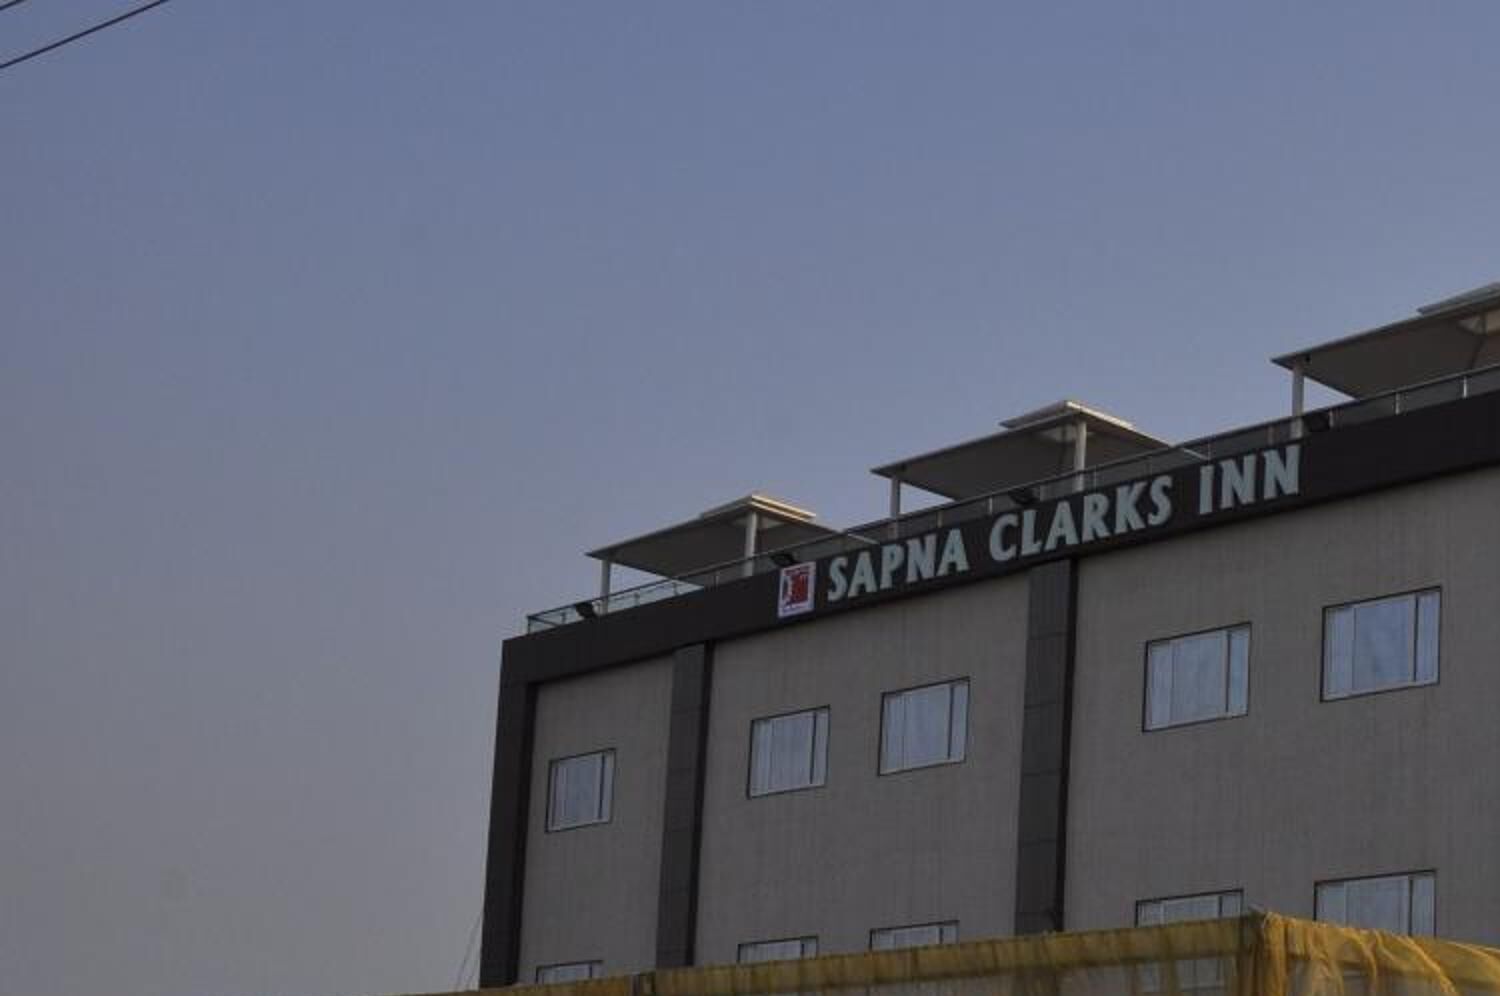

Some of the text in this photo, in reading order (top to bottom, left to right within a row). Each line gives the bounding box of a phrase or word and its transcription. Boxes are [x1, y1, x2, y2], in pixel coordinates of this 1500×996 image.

[828, 445, 1302, 602] SAPNA CLARKS INN
